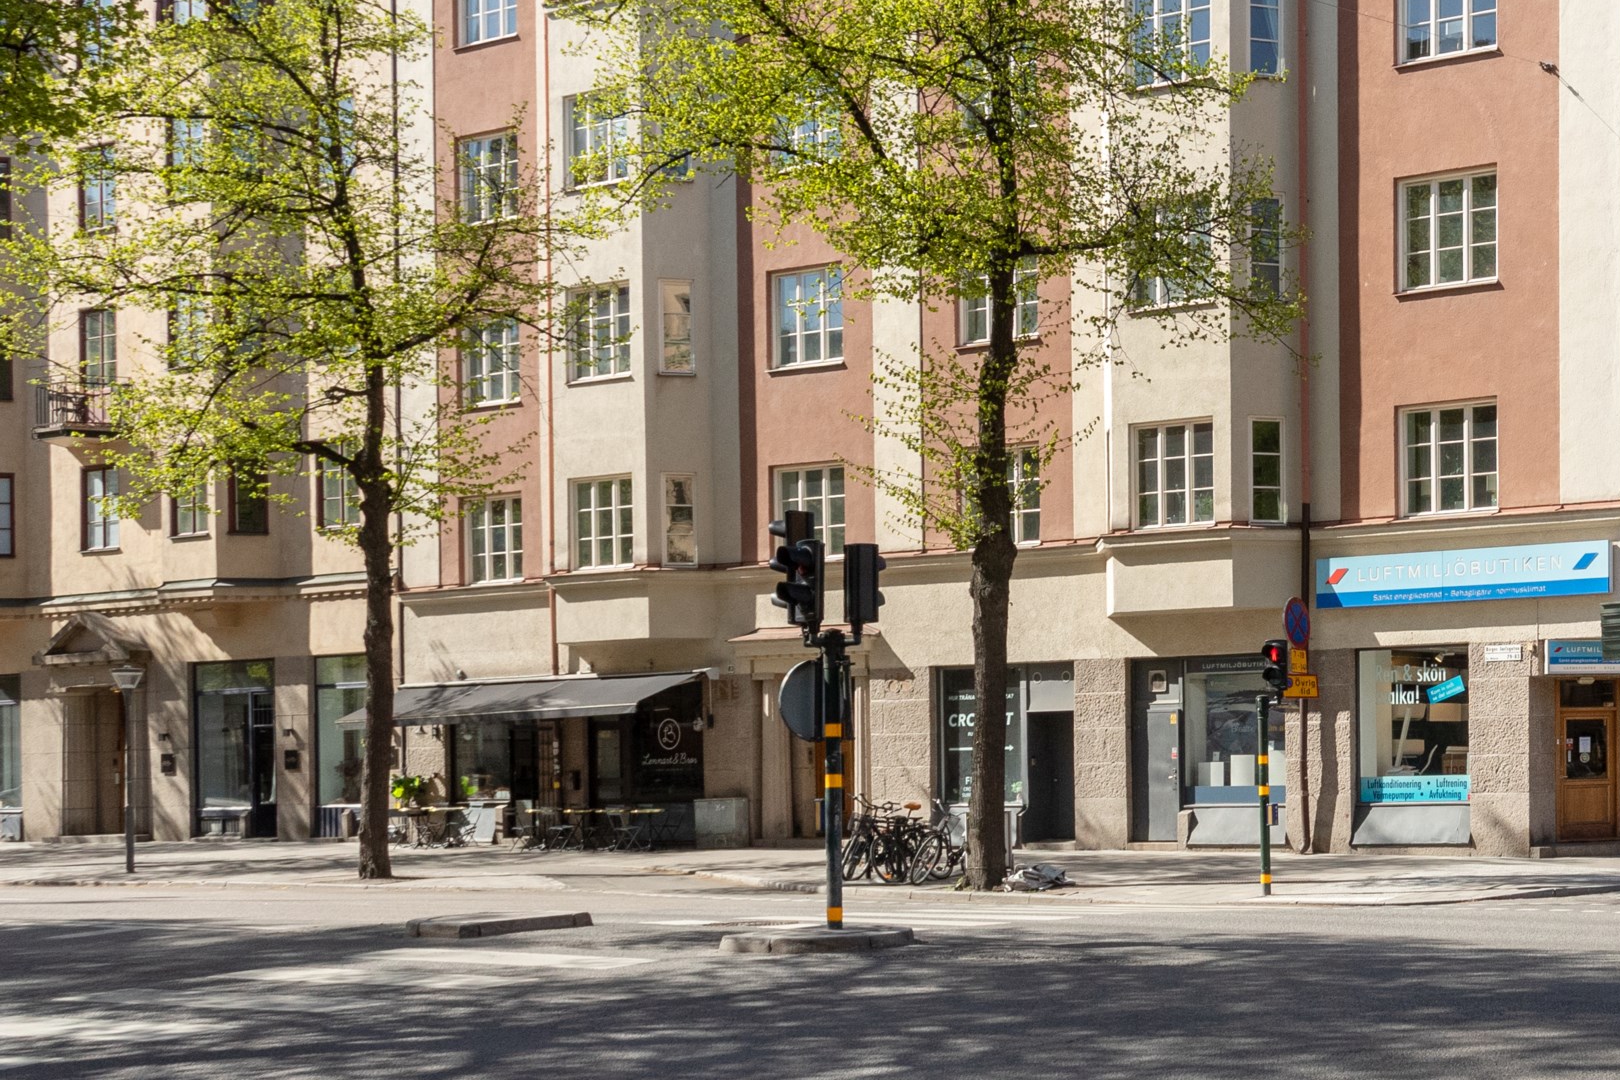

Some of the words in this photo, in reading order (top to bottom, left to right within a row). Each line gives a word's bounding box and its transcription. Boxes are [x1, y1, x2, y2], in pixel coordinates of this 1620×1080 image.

[1356, 555, 1564, 582] LUFTMILJÖBUTIKEN
[1416, 660, 1447, 682] skön
[1295, 678, 1316, 689] Övrig
[1300, 687, 1311, 695] tid
[1388, 683, 1420, 705] alka!
[1367, 778, 1422, 790] Luftkonditionering
[1436, 777, 1468, 789] Luftrening
[1428, 788, 1462, 800] Avfuktning
